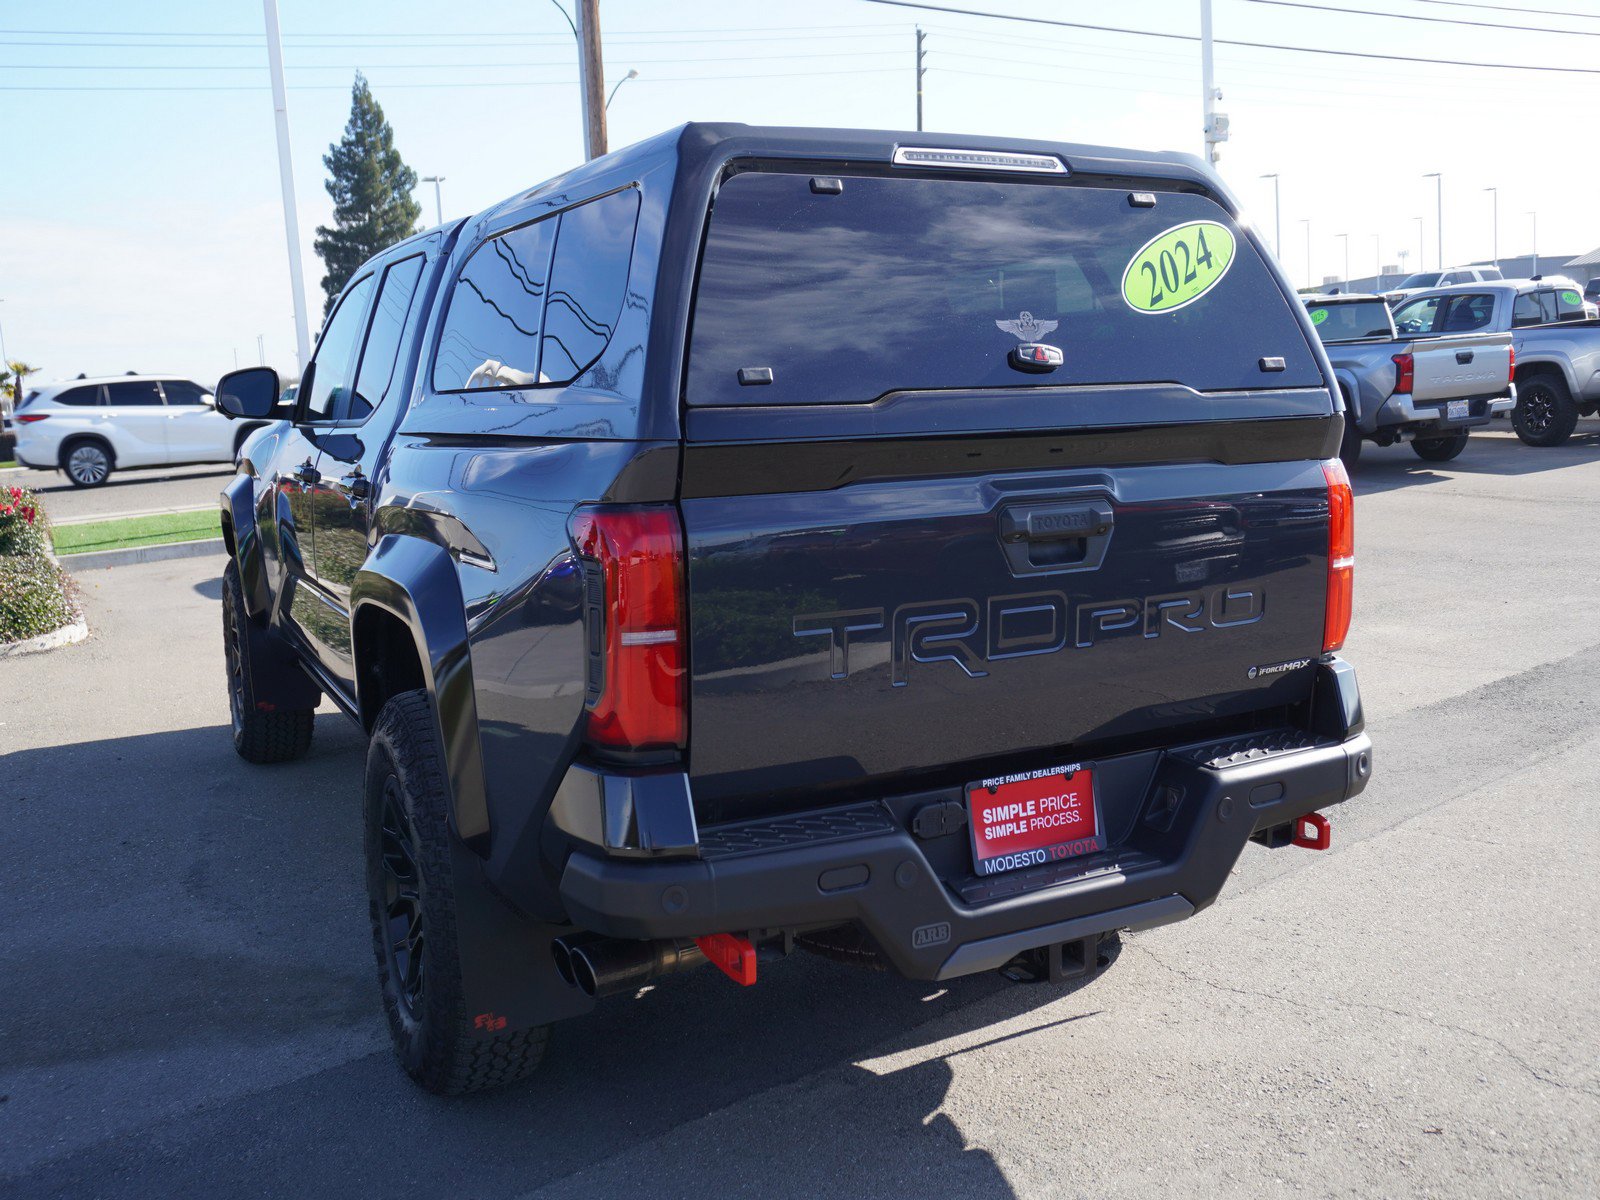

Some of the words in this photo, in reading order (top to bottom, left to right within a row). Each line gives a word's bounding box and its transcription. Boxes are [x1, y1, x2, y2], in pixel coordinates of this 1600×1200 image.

[1141, 226, 1213, 308] 2024
[1430, 371, 1497, 384] TACOMA
[1035, 513, 1088, 530] TOYOTA
[982, 776, 1005, 788] PRICE
[1006, 772, 1031, 784] FAMILY
[1033, 763, 1081, 779] DEALERSHIPS
[982, 800, 1036, 824] SIMPLE
[1039, 792, 1082, 814] PRICE.
[984, 820, 1028, 840] SIMPLE
[1030, 810, 1083, 831] PROCESS.
[984, 849, 1046, 874] MODESTO
[1049, 839, 1099, 860] TOYOTA
[916, 925, 948, 945] ARB
